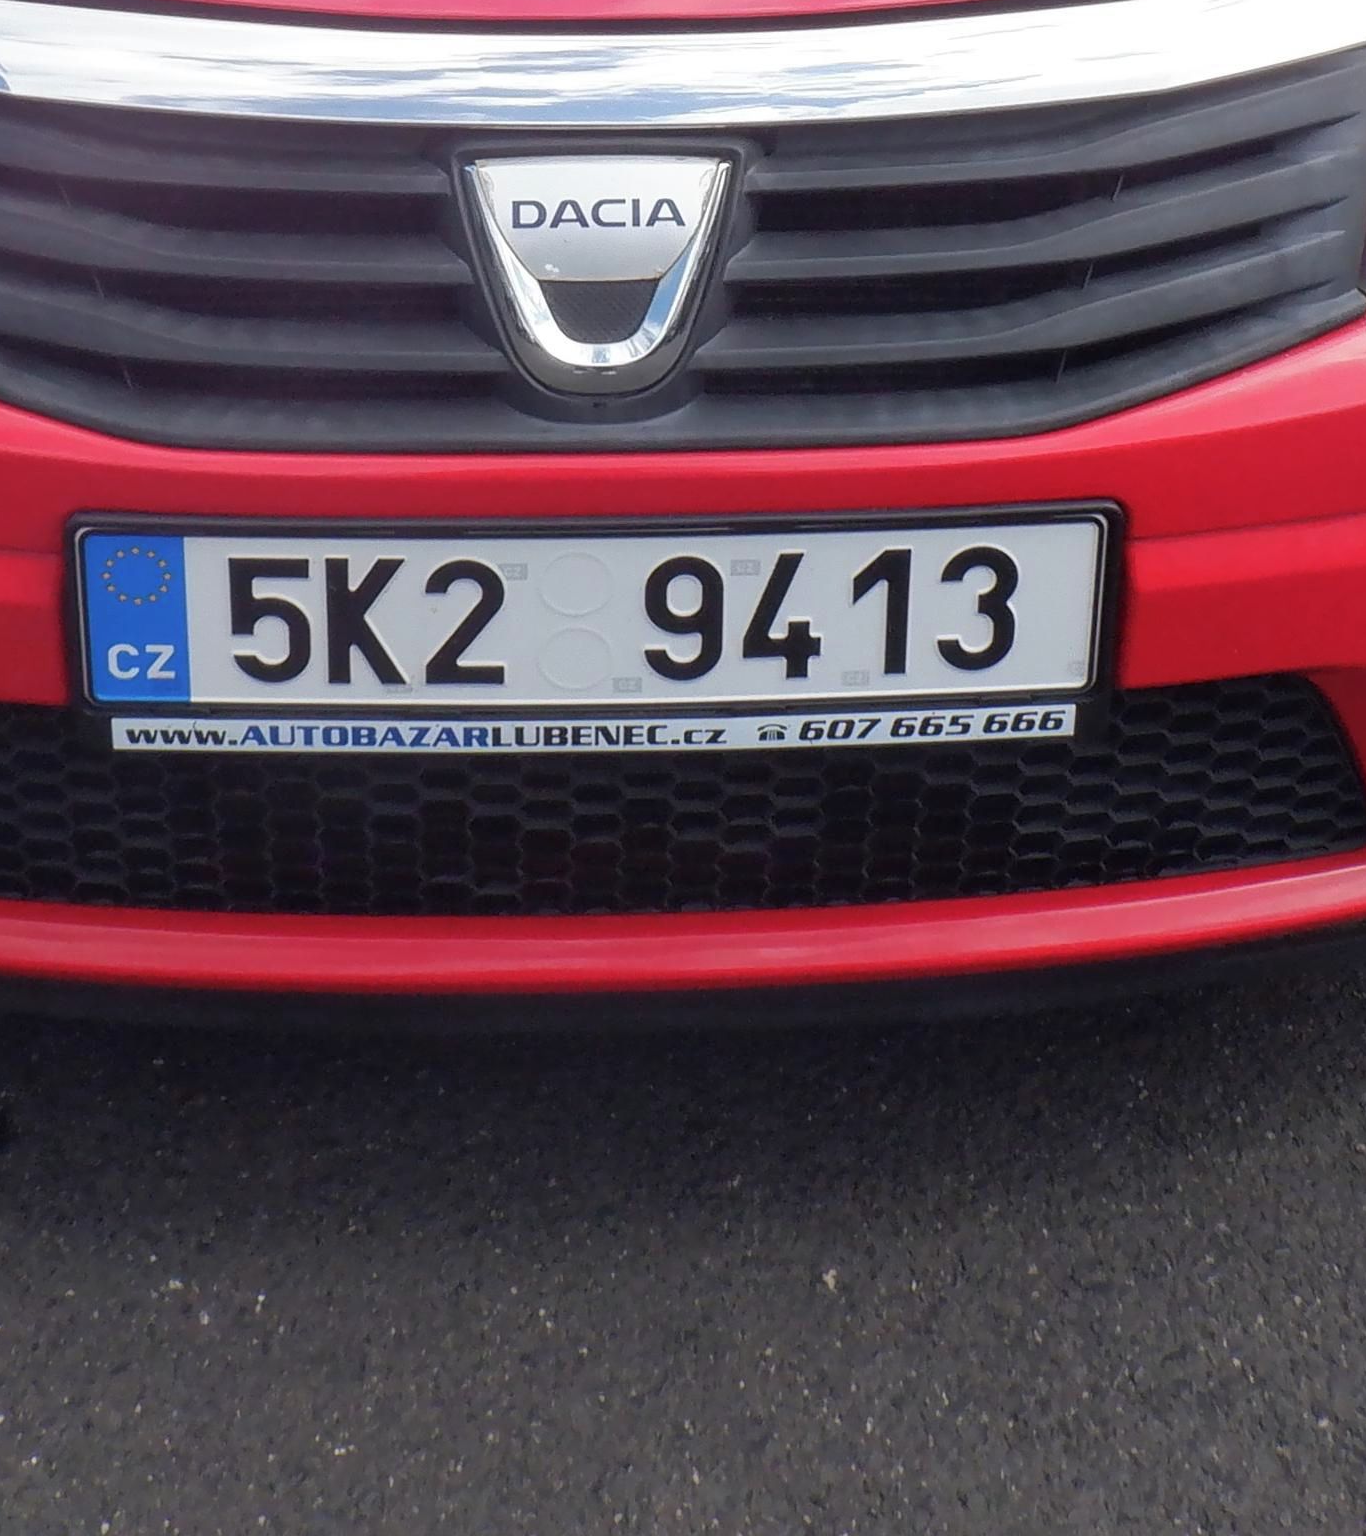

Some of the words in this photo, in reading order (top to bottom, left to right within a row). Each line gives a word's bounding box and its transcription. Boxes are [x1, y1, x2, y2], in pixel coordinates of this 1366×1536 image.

[511, 198, 686, 230] DACIA
[107, 643, 176, 680] CZ
[227, 557, 506, 685] 5K2
[643, 545, 1020, 681] 9413
[125, 723, 727, 750] www.AUTOBAZARLUBENEC.cz
[798, 717, 882, 742] 607
[890, 713, 973, 739] 665
[981, 709, 1068, 734] 666
